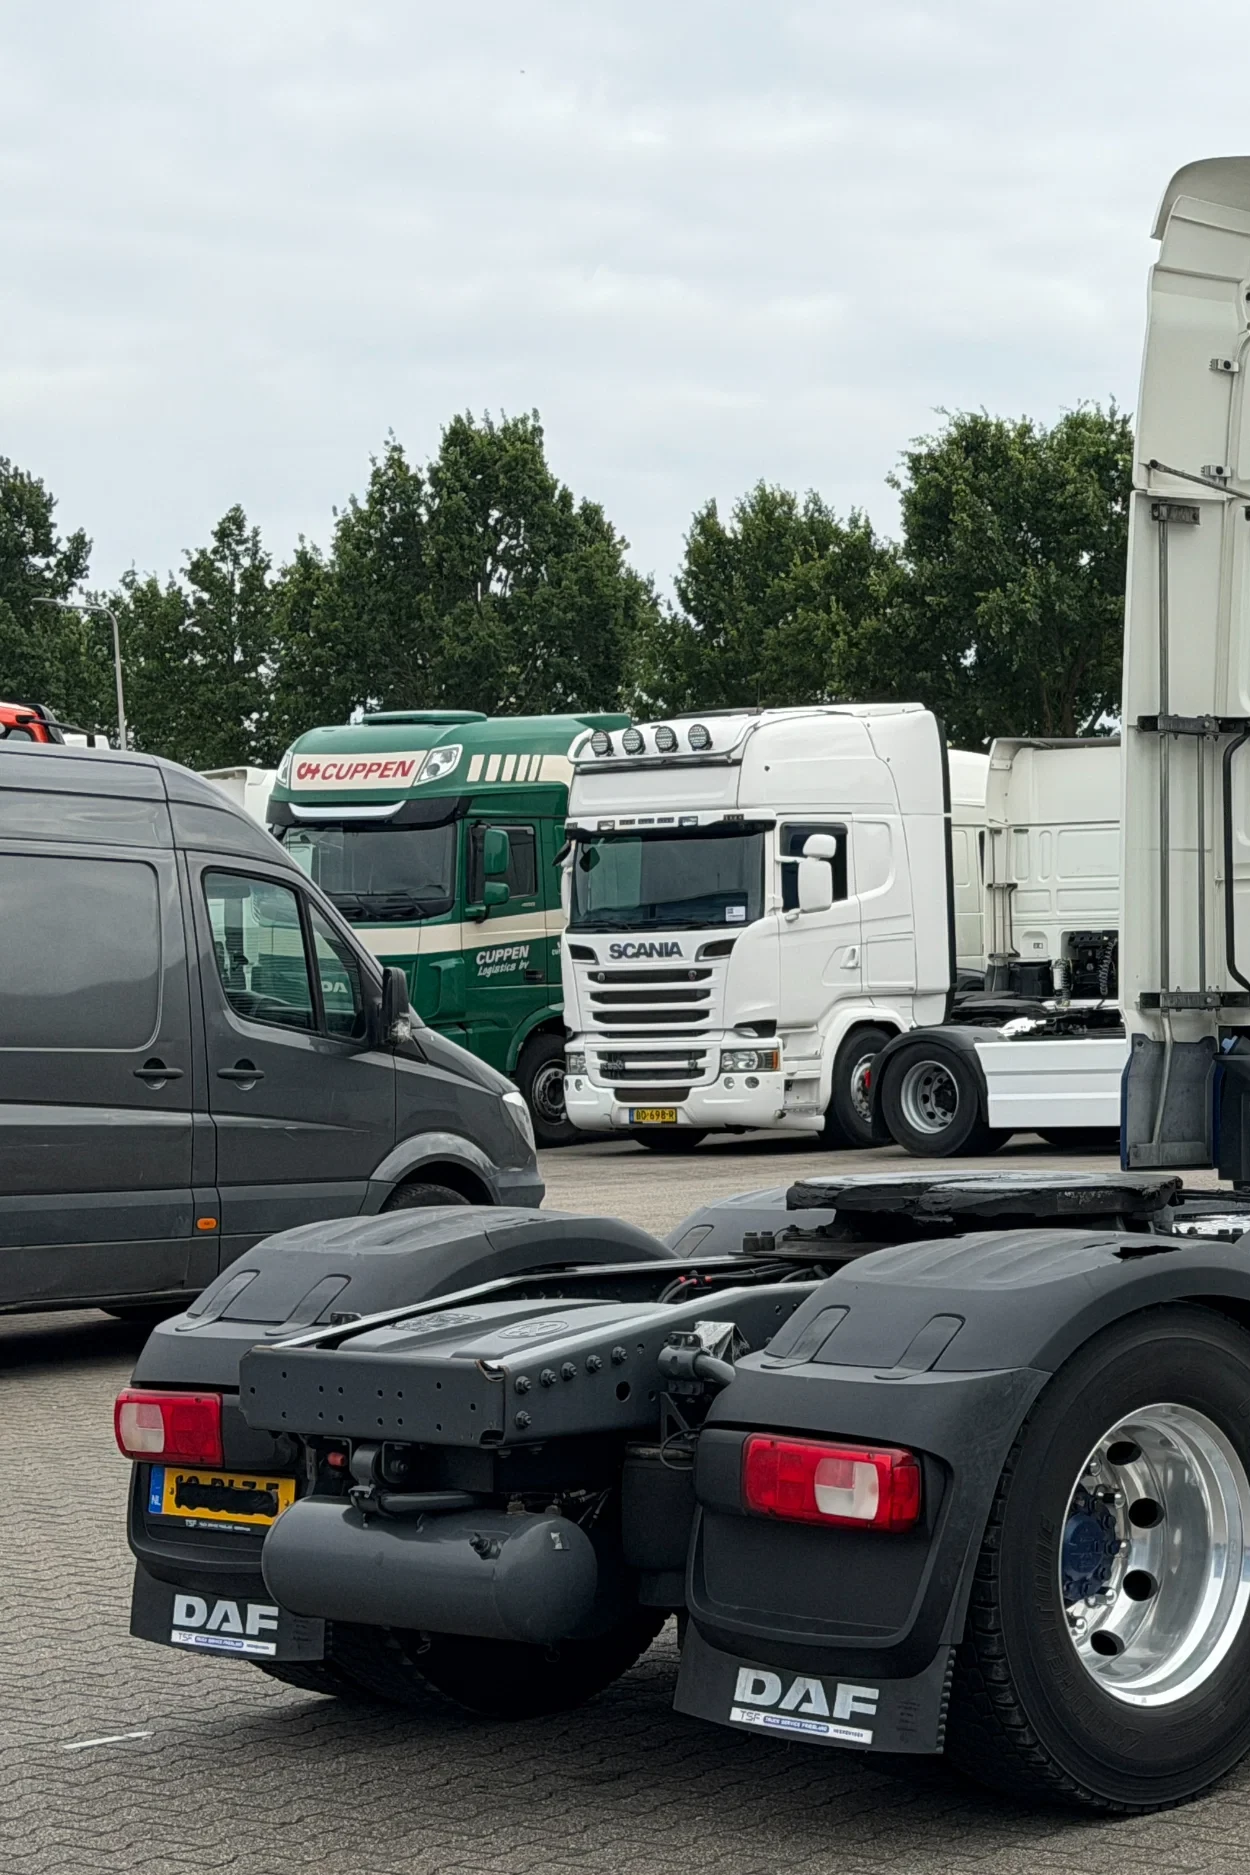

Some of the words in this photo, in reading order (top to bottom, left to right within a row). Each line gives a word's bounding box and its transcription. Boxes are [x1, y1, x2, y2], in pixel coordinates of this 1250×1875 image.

[321, 760, 416, 780] CUPPEN
[476, 945, 530, 965] CUPPEN
[609, 941, 684, 960] SCANIA
[477, 962, 516, 978] Logistics
[321, 980, 349, 993] DA
[172, 1593, 279, 1636] DAF
[733, 1667, 880, 1720] DAF
[740, 1709, 761, 1722] TSF
